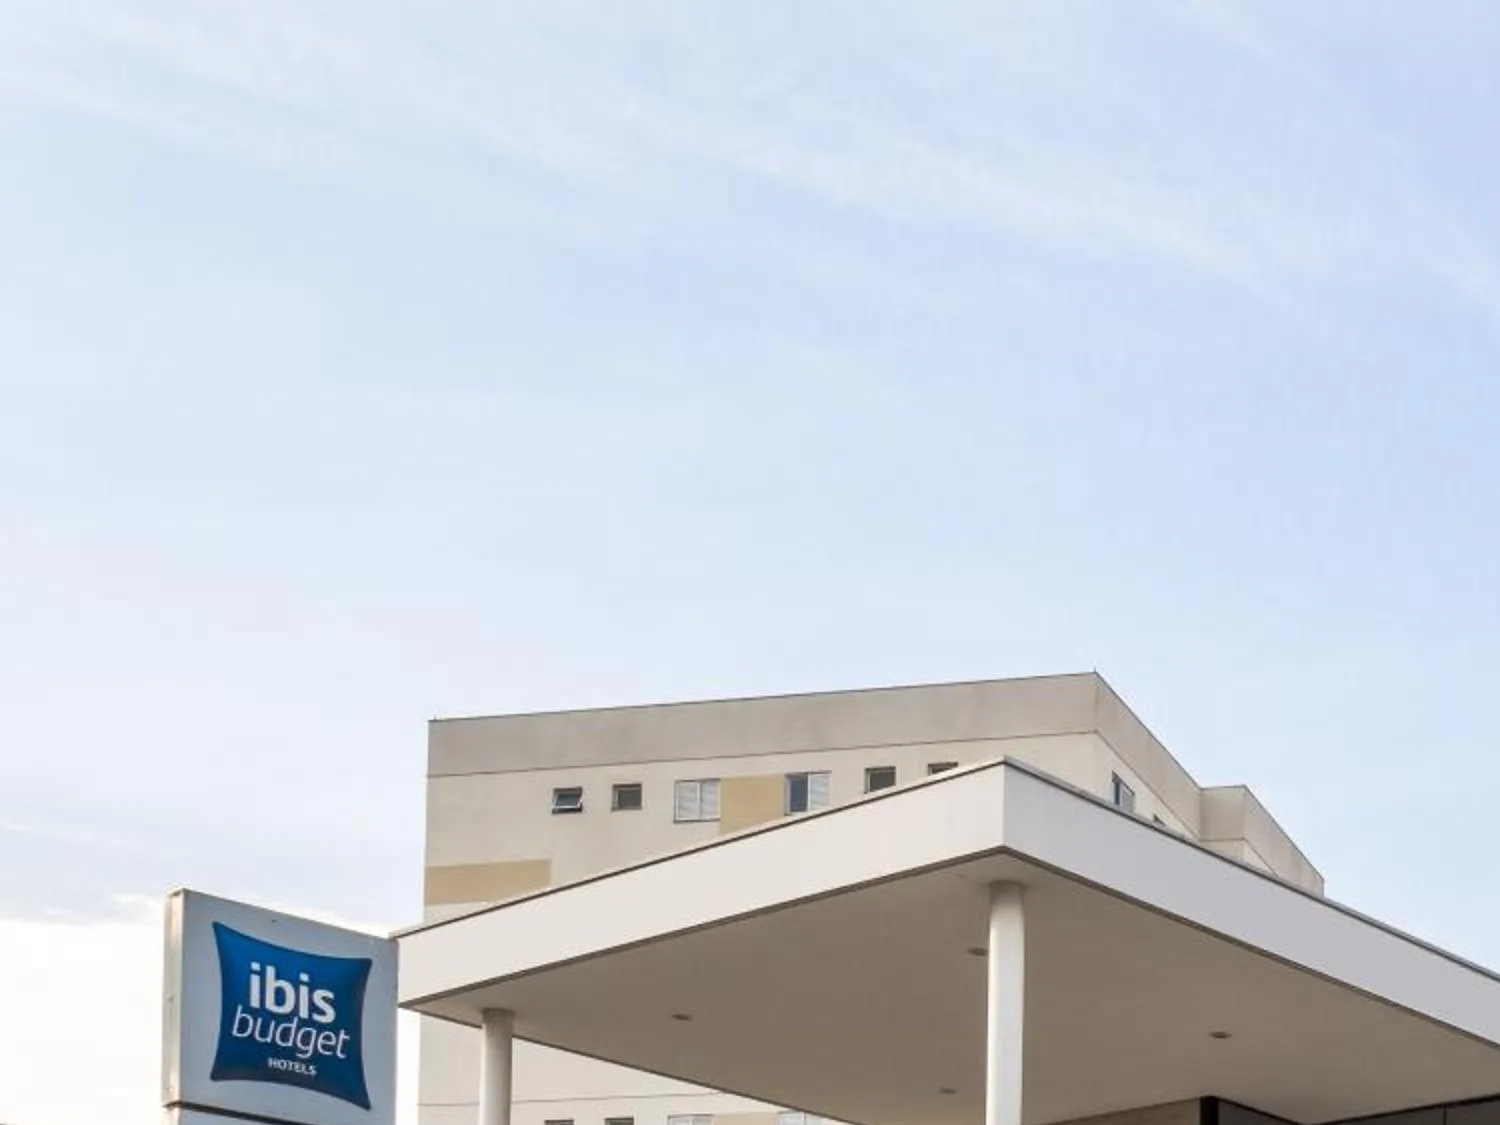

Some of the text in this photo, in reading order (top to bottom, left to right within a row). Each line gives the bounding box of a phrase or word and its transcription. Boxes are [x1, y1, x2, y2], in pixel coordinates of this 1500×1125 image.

[250, 961, 336, 1023] ibis
[231, 1004, 350, 1059] budget
[268, 1057, 317, 1077] HOTELS
